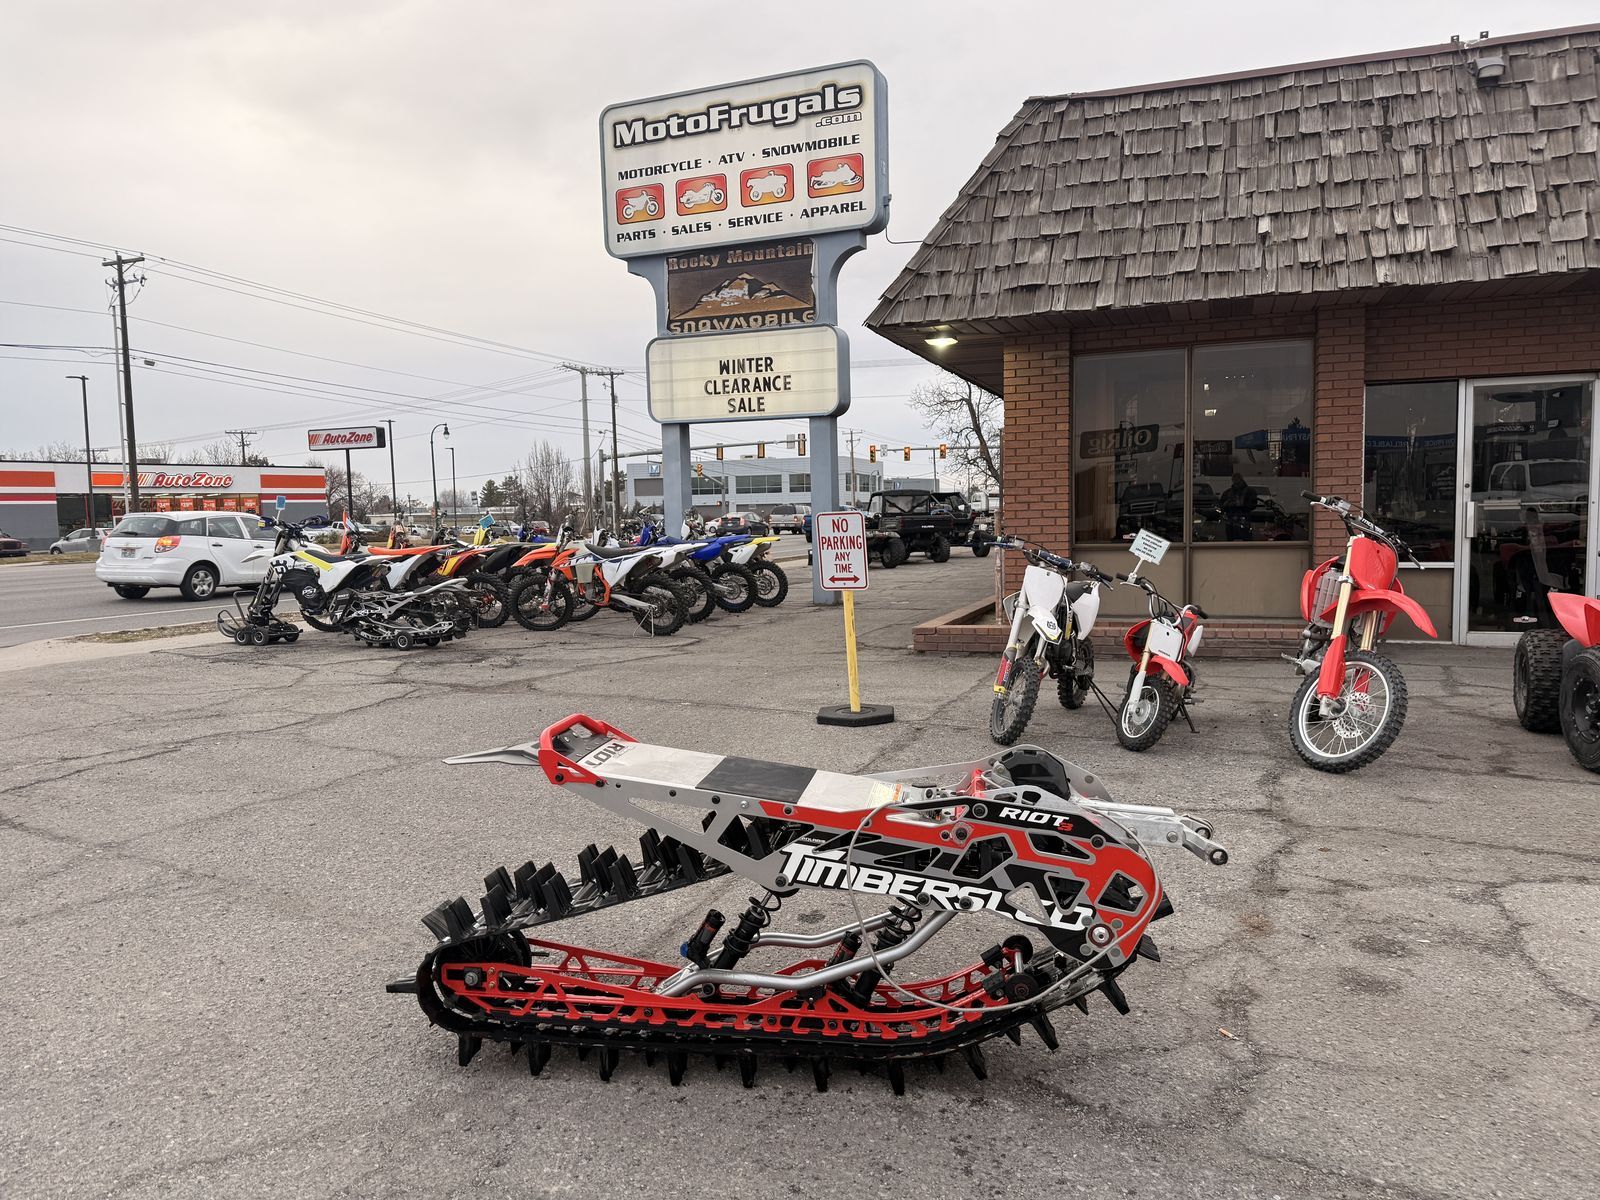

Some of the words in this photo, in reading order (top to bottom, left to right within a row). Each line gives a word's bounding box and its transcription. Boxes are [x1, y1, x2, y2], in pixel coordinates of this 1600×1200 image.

[613, 84, 863, 148] MotoFrugals
[815, 111, 862, 128] .com
[618, 159, 702, 181] MOTORCYCLE
[718, 152, 745, 165] ATV
[761, 134, 860, 159] SNOWMOBILE
[616, 228, 656, 243] PARTS
[671, 221, 712, 236] SALES
[728, 211, 783, 229] SERVICE
[800, 200, 867, 219] APPAREL
[668, 253, 720, 271] Rocky
[727, 242, 814, 264] Mountain
[719, 356, 774, 375] WINTER
[704, 375, 792, 395] CLEARANCE
[727, 397, 766, 413] SALE
[322, 431, 374, 445] AutoZone
[154, 472, 233, 489] AutoZone
[831, 518, 849, 533] NO
[821, 535, 863, 551] PARKING
[834, 552, 851, 562] ANY
[834, 563, 853, 574] TIME
[999, 807, 1070, 827] RIOT
